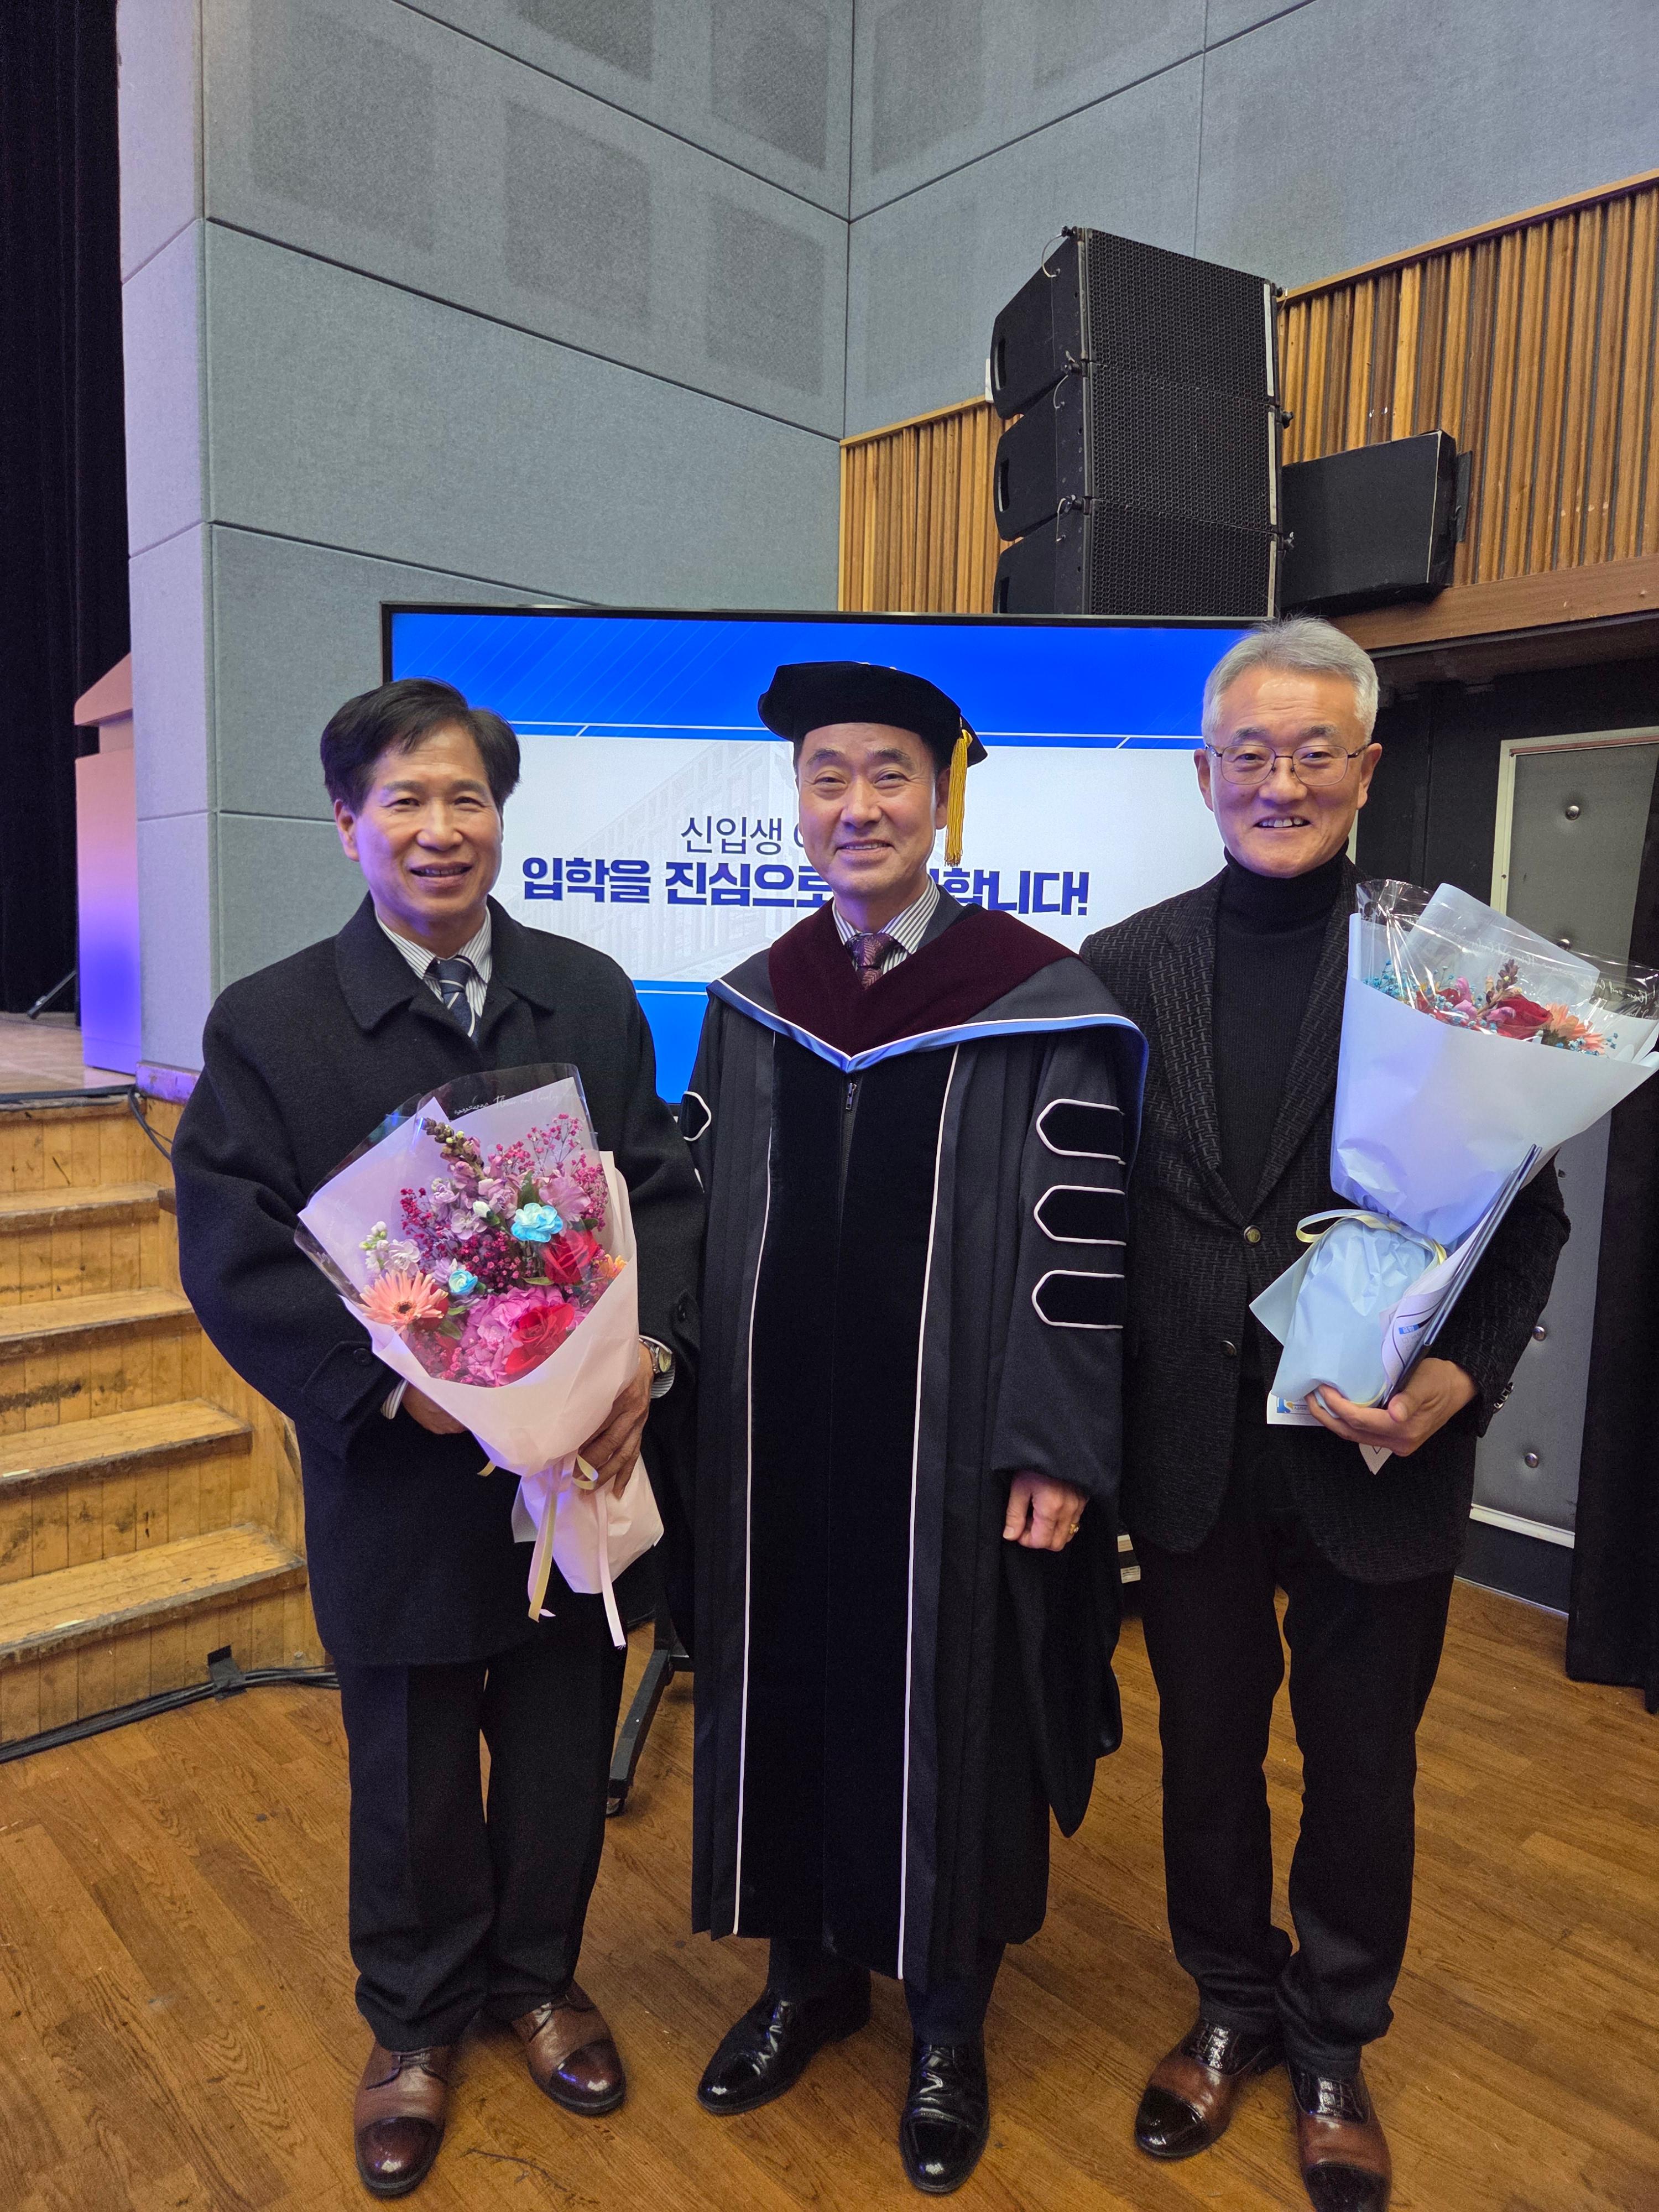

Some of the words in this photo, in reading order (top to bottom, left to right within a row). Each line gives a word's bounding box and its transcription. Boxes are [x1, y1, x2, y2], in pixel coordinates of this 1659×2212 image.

[681, 816, 782, 855] 신입생
[522, 857, 651, 903] 입학을
[665, 862, 832, 908] 진심으로
